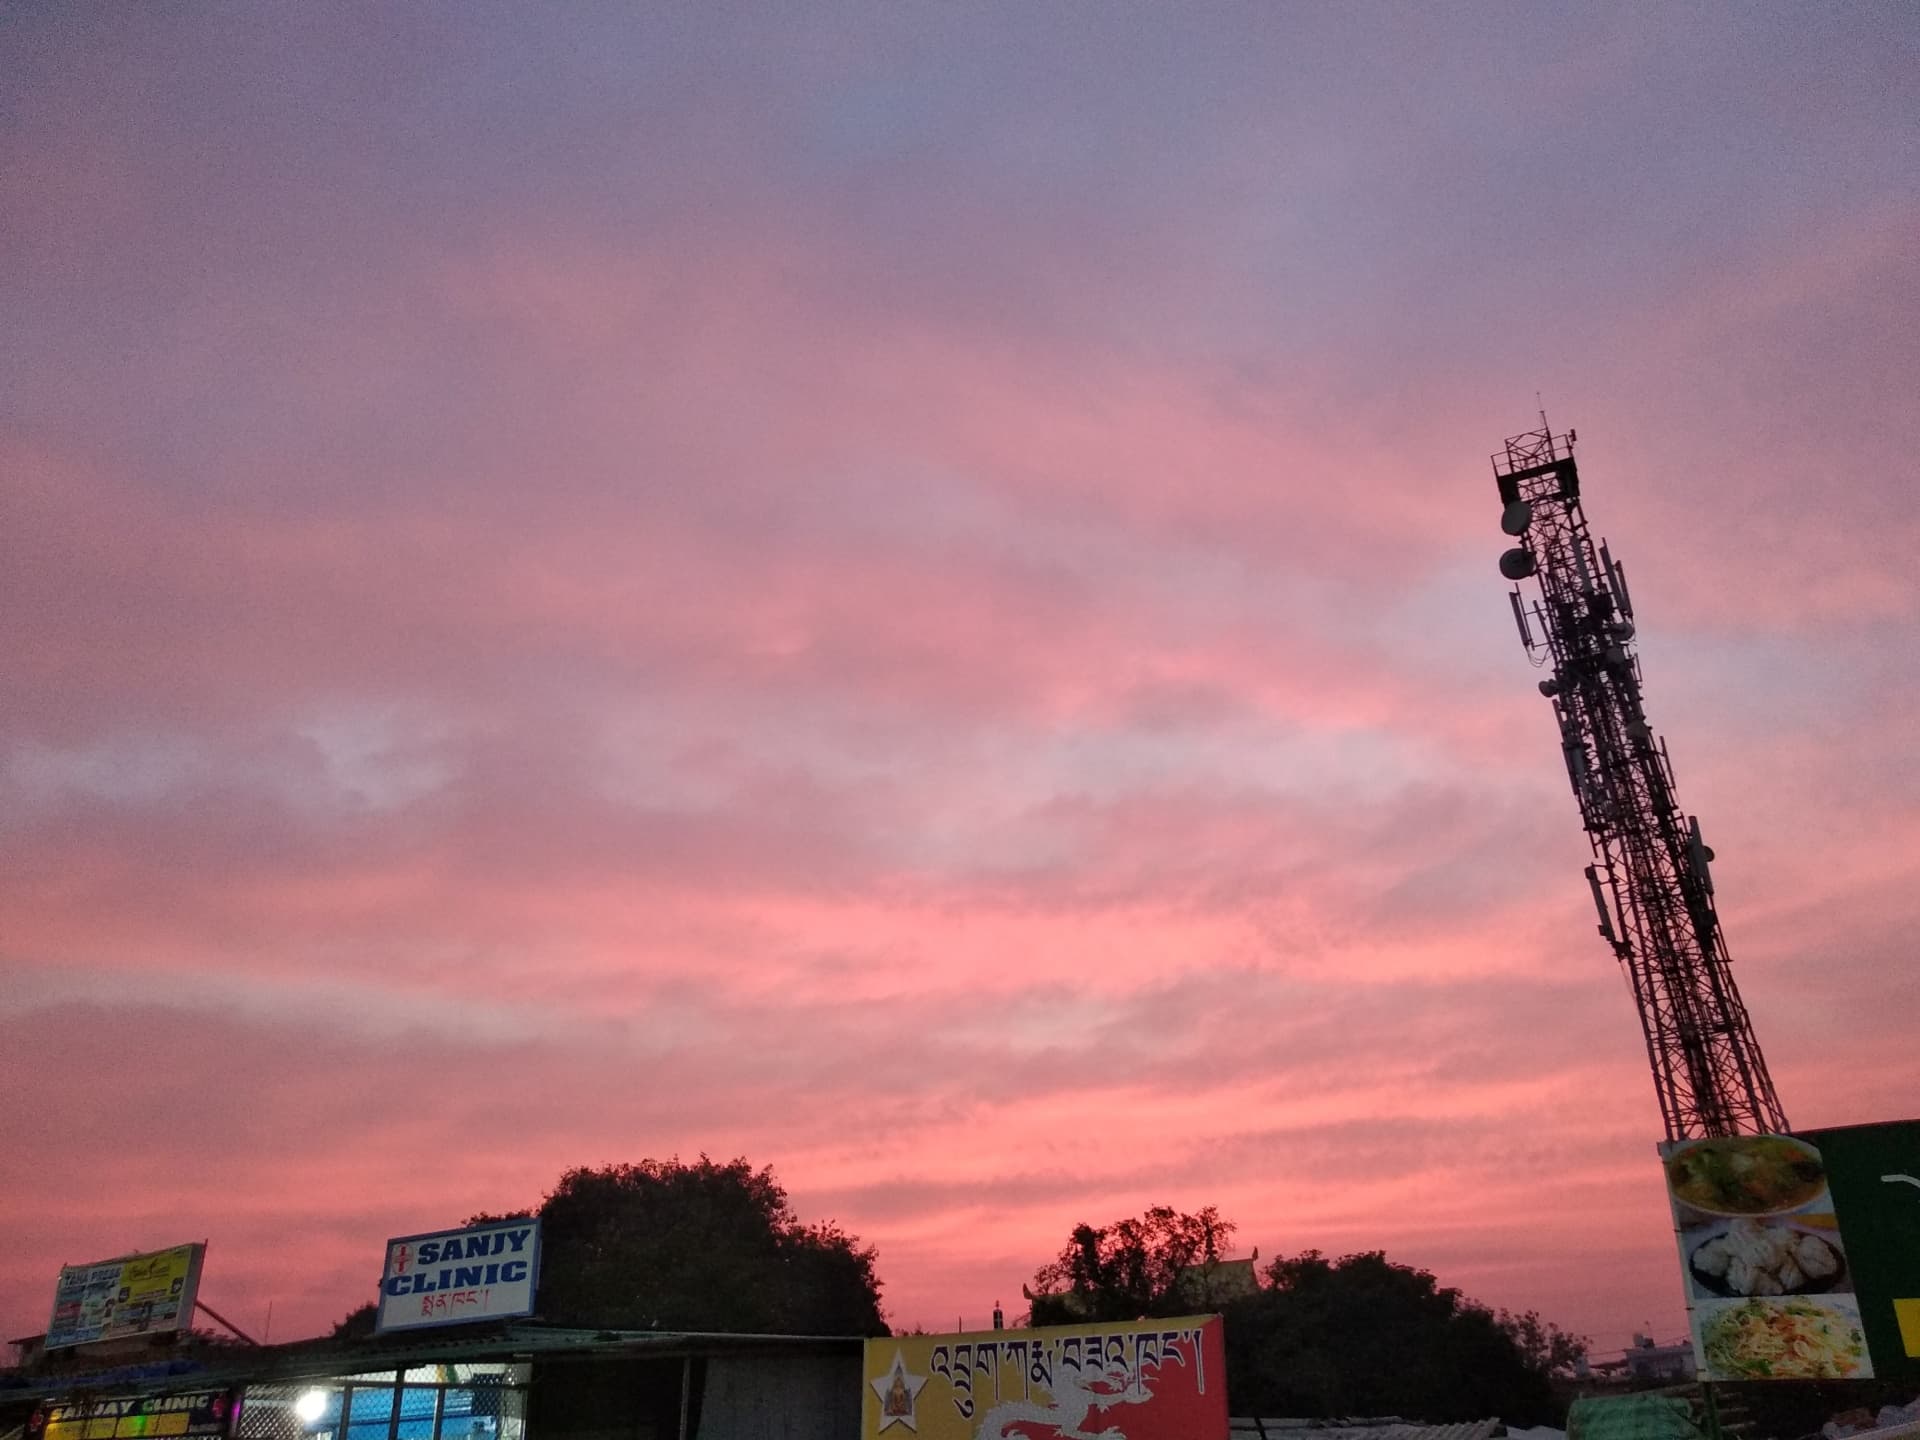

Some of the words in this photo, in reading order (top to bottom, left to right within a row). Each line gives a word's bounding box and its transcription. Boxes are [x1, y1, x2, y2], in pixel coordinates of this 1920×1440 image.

[418, 1229, 531, 1265] SANJY
[385, 1261, 528, 1296] CLINIC
[143, 1395, 209, 1412] CLINIC
